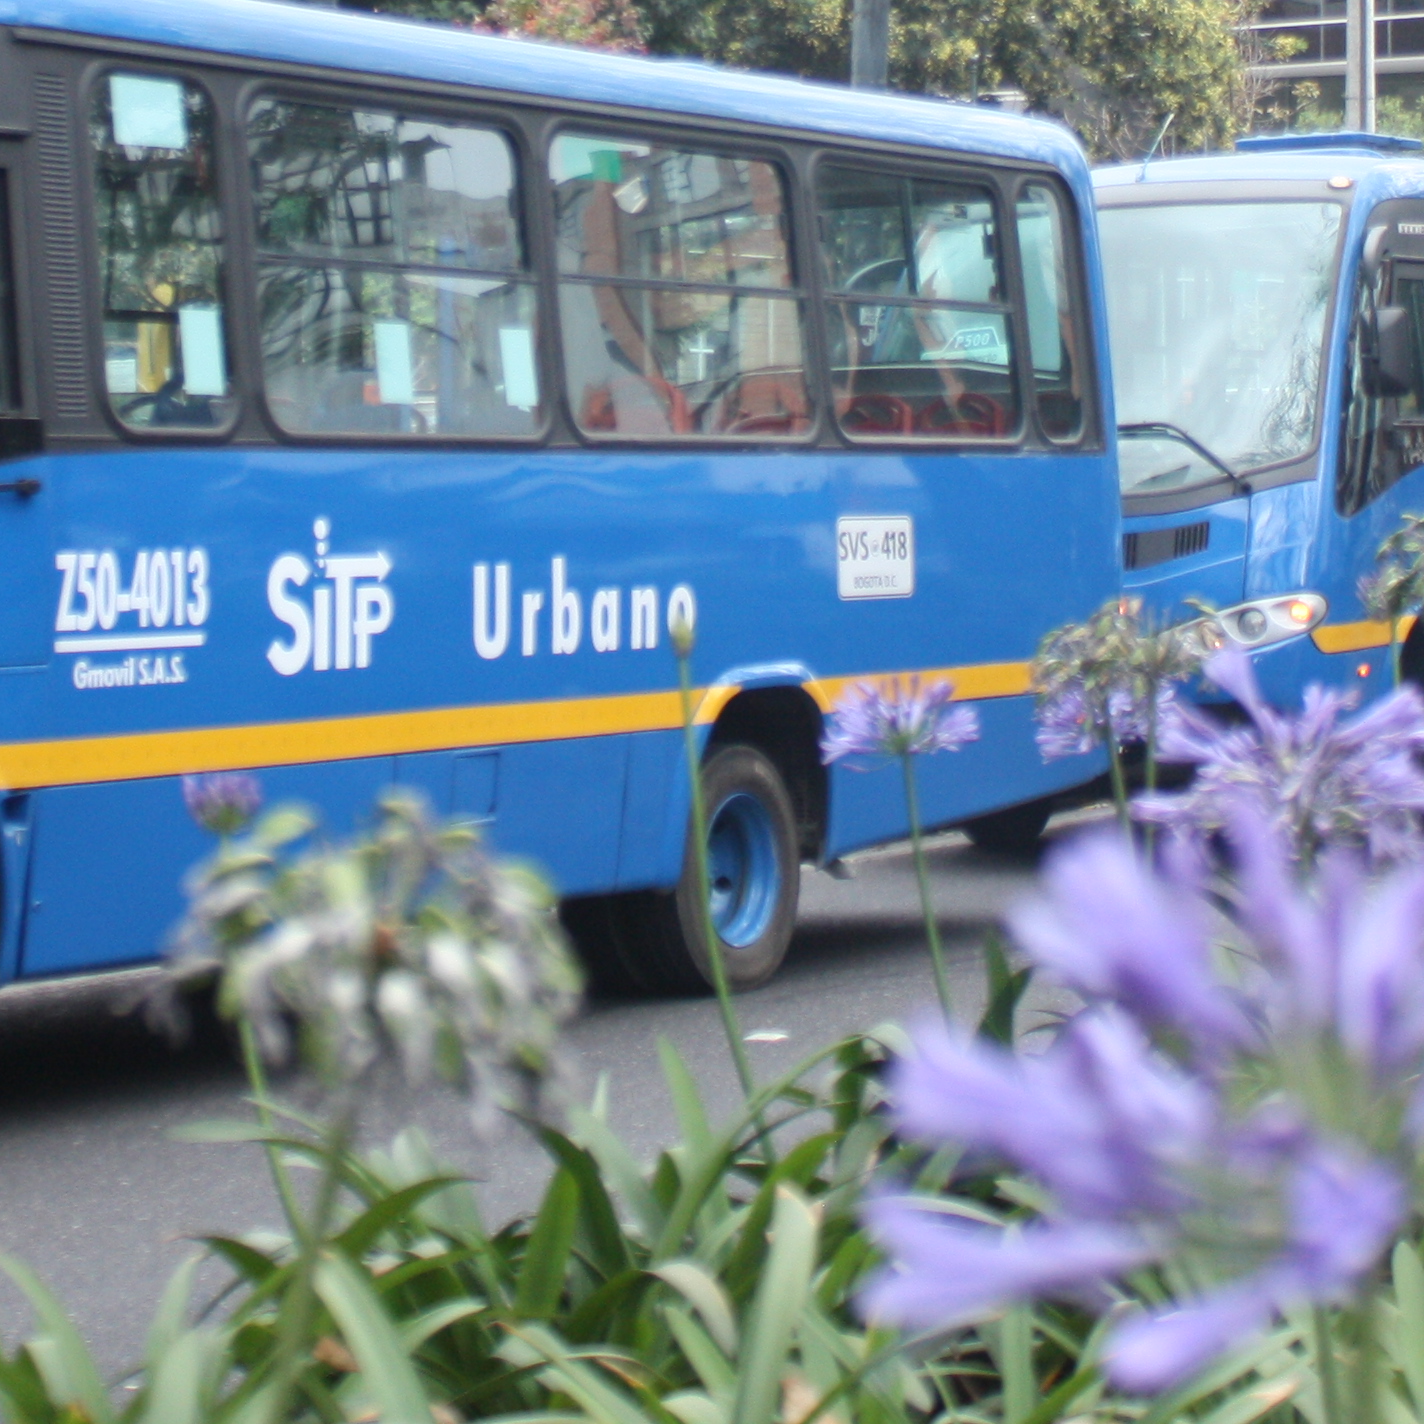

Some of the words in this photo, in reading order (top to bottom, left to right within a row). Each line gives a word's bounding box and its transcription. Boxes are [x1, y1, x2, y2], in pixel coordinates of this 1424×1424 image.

[55, 550, 208, 632] Z50-4013
[472, 557, 696, 659] Urbano
[74, 658, 134, 689] Gmovil
